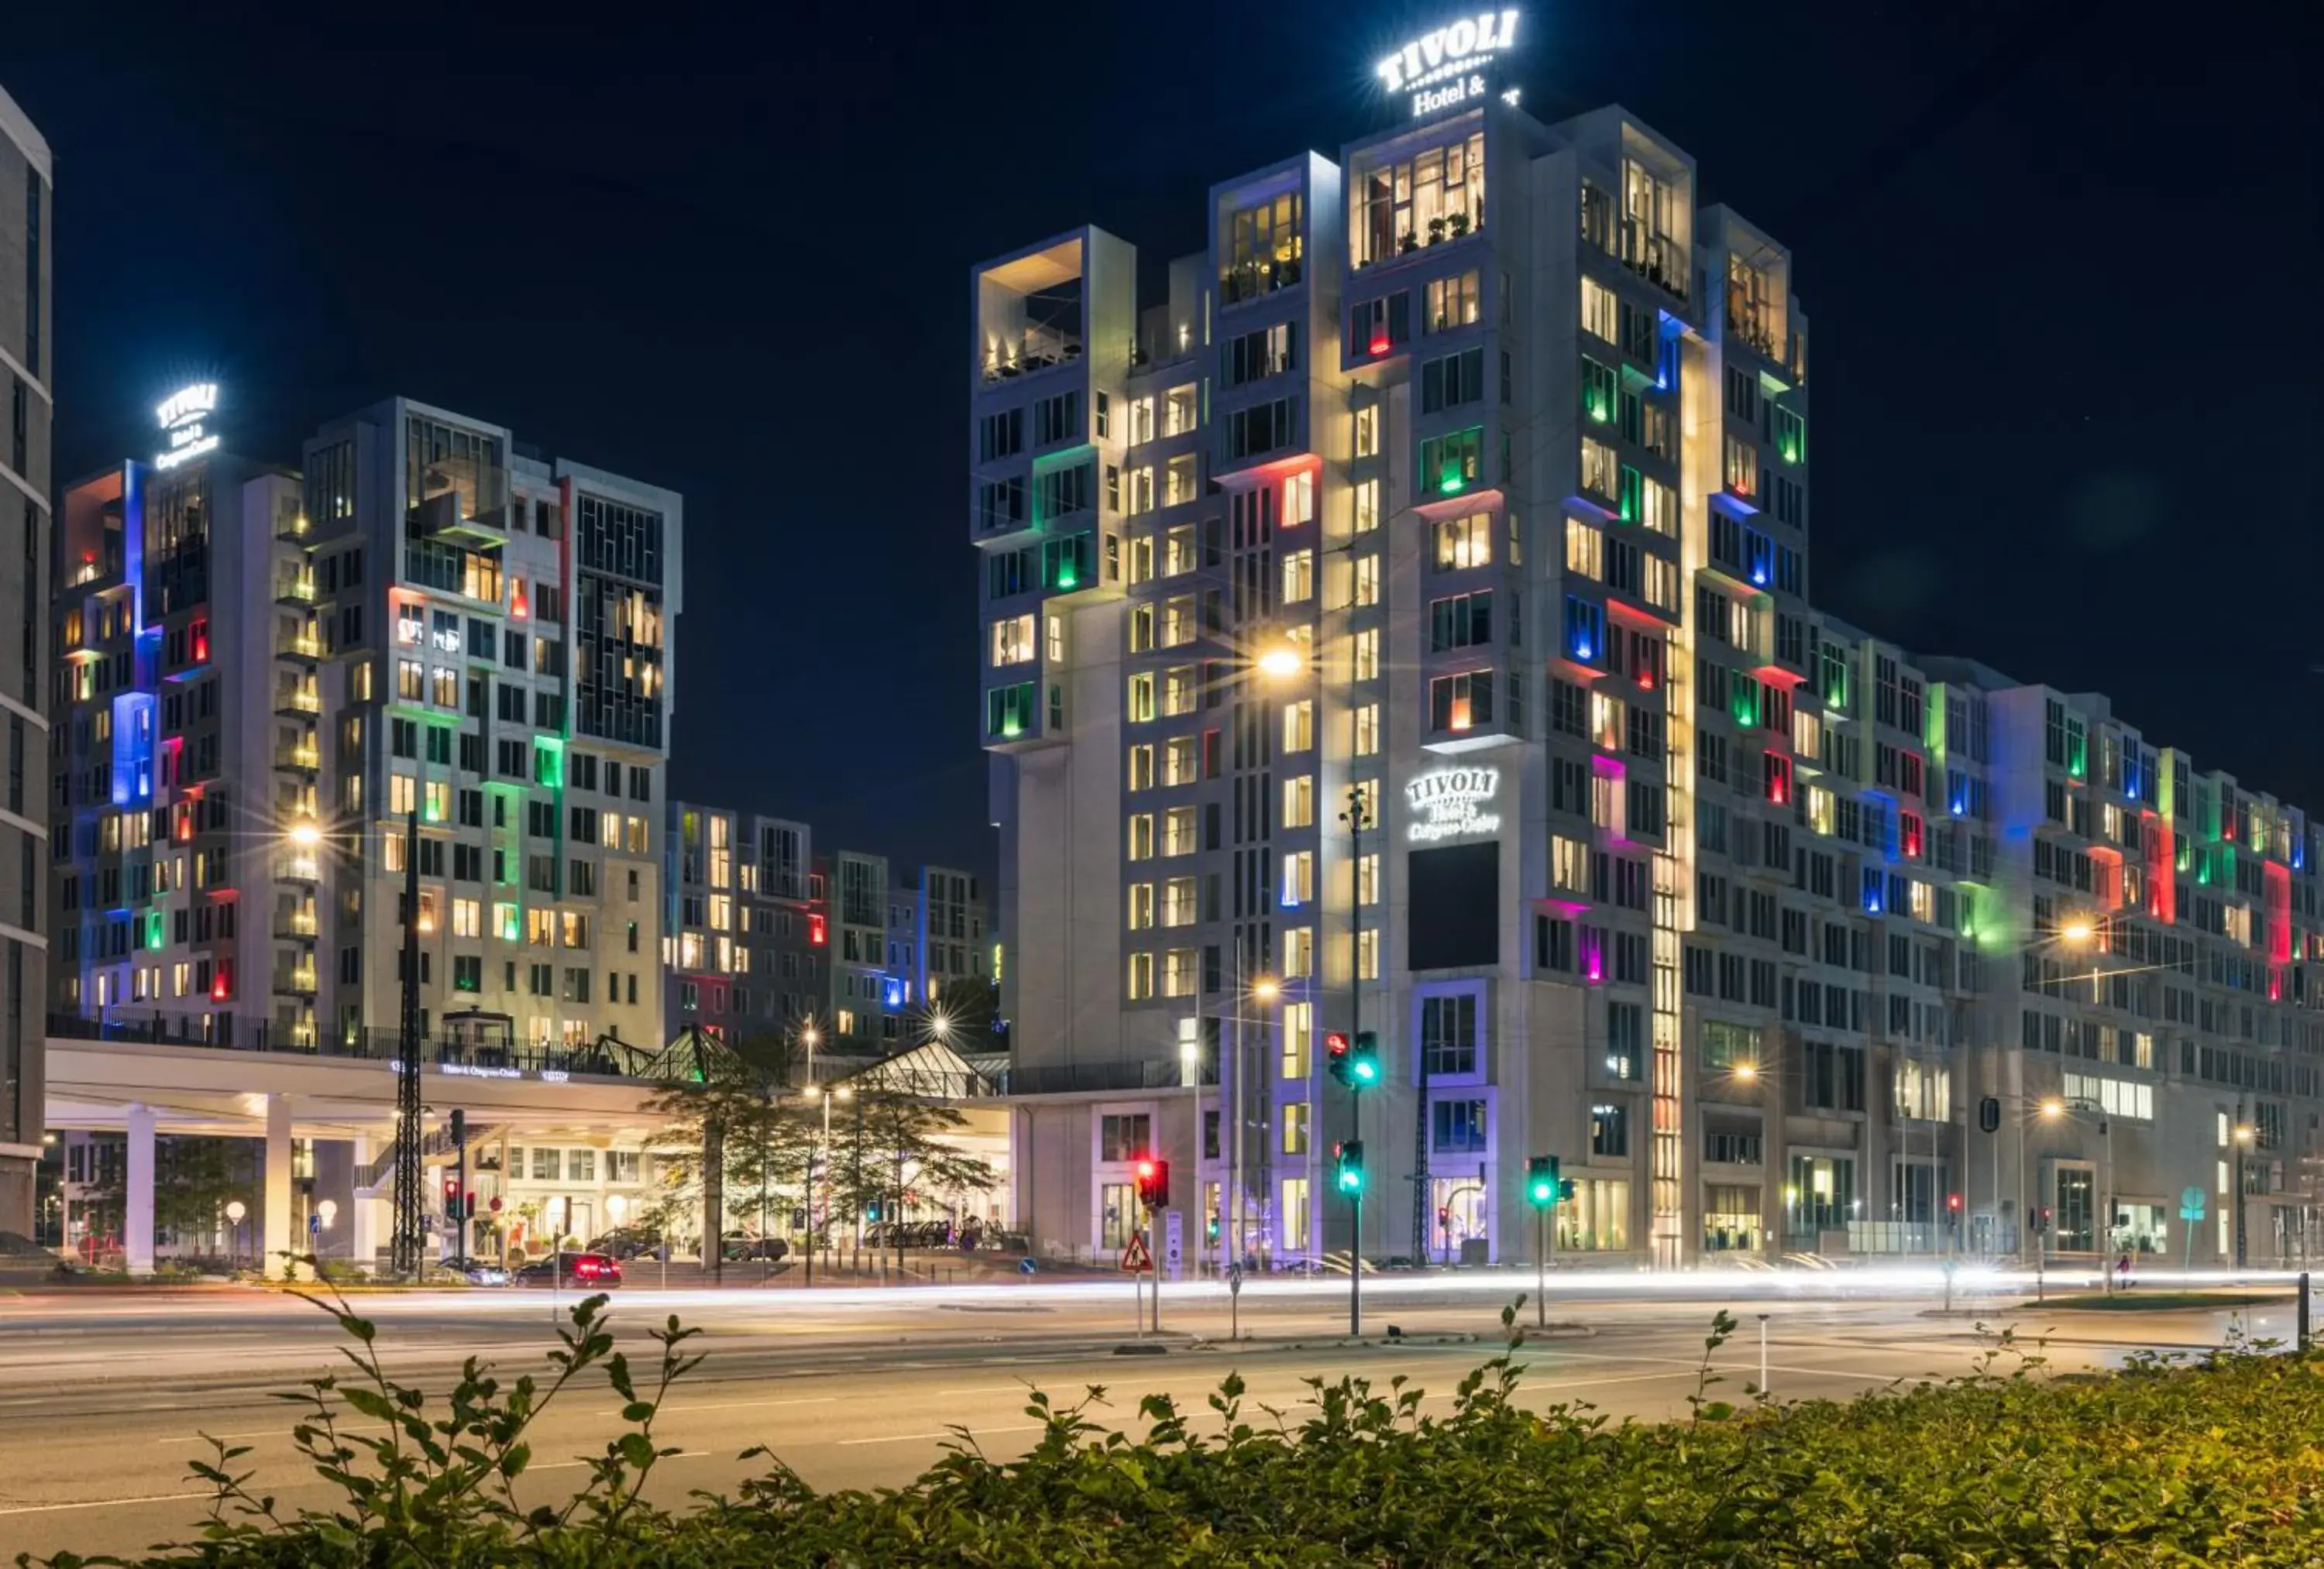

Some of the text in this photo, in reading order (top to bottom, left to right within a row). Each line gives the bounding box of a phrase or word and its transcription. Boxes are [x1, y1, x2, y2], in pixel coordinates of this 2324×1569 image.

[1377, 10, 1519, 92] TIVOLI
[1413, 77, 1465, 117] Hotel
[1469, 74, 1485, 96] &
[157, 383, 218, 428] TIVOLI
[1406, 769, 1498, 806] TIVOLI
